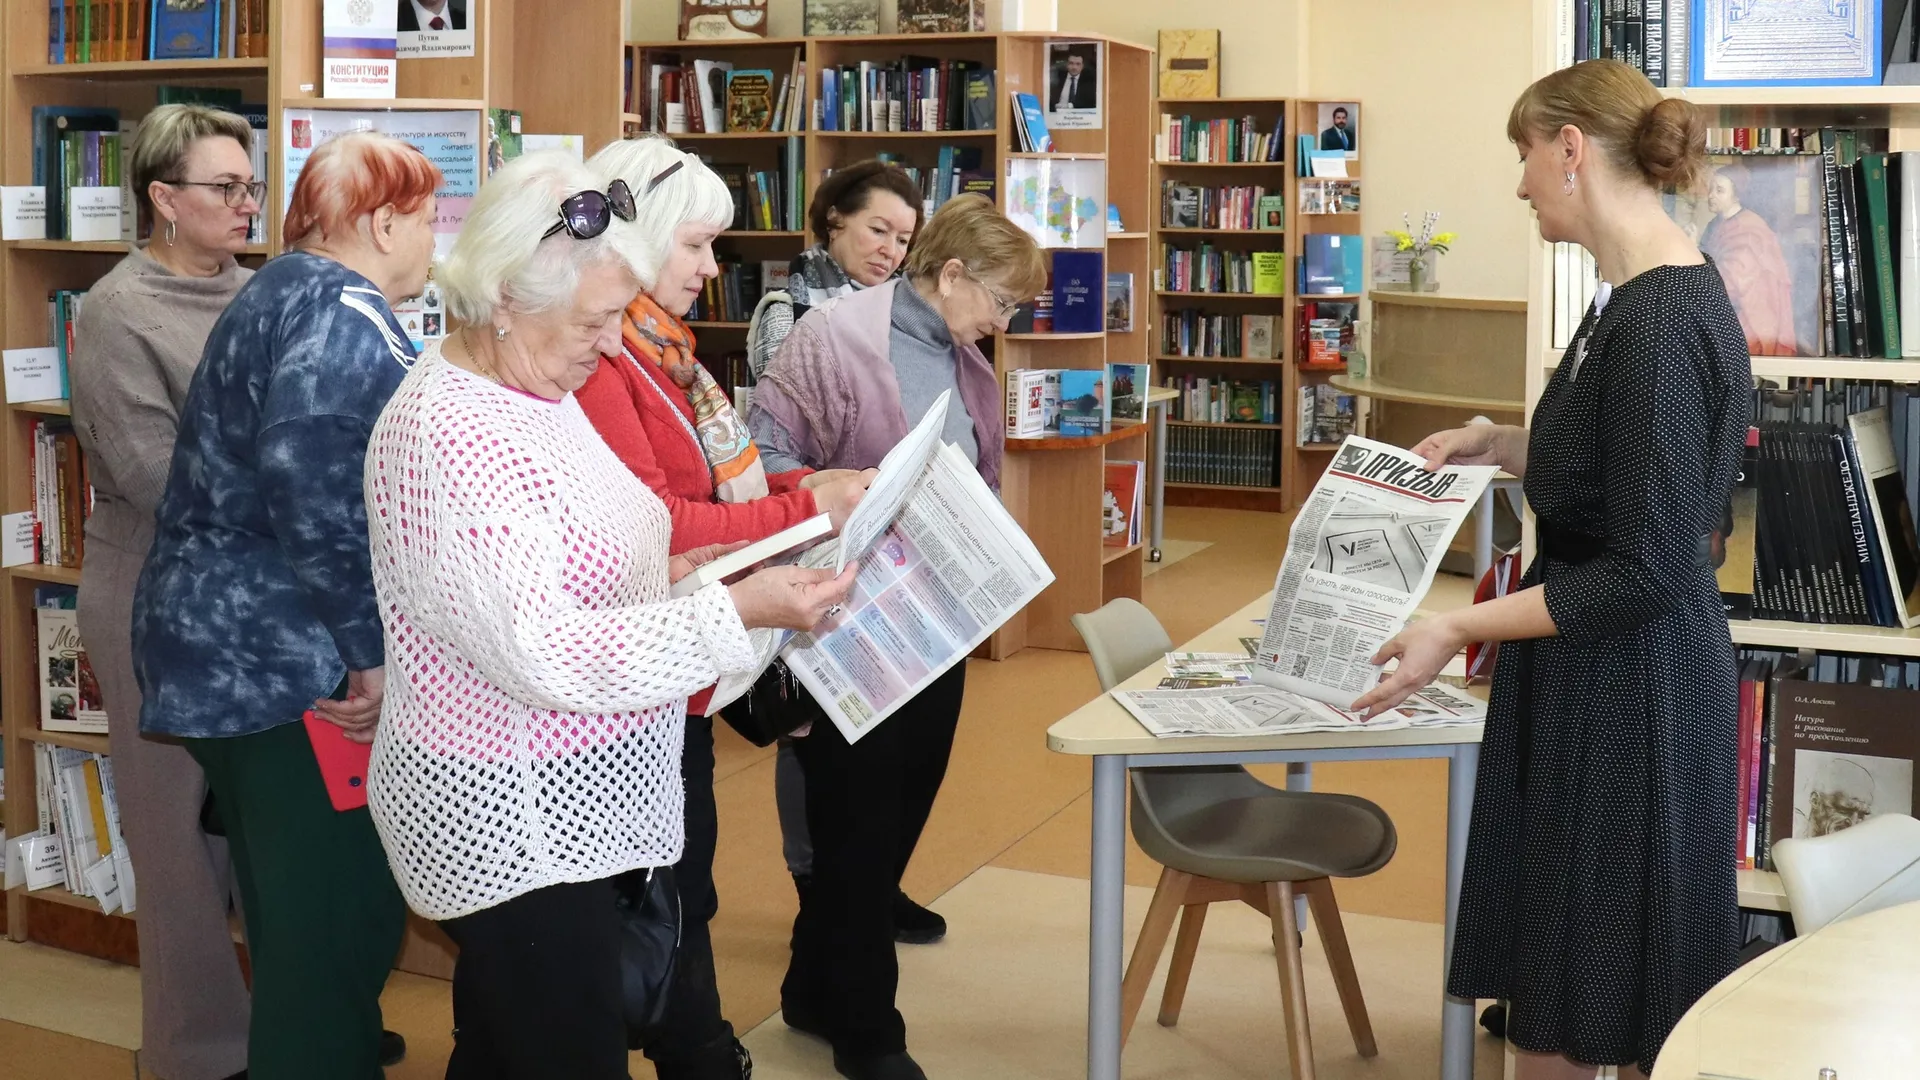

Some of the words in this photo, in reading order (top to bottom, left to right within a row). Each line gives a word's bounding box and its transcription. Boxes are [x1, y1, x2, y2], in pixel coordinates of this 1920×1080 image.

[418, 34, 439, 43] Путин
[396, 45, 420, 53] адимир
[421, 44, 471, 52] Владимирович
[1646, 23, 1662, 69] ИСТОРИЯ
[330, 64, 389, 77] КОНСТИТУЦИЯ
[434, 131, 467, 139] искусству
[428, 155, 473, 163] олоссальный
[441, 167, 473, 175] репление
[1824, 144, 1839, 210] РИСУНОК
[434, 191, 473, 199] огатейшего
[1359, 452, 1459, 498] ПРИЗЫВ
[1838, 459, 1870, 564] МИКЕЛАНДЖЕЛО
[924, 478, 963, 523] Внимание,
[957, 519, 999, 569] мошенники!
[1303, 572, 1315, 582] Как
[1315, 578, 1337, 590] узнать,
[1338, 583, 1350, 592] где
[1350, 586, 1365, 595] вам
[1364, 587, 1410, 607] голосовать?
[1794, 713, 1825, 725] Натура
[1803, 724, 1846, 734] рисование
[1808, 733, 1870, 744] представлению
